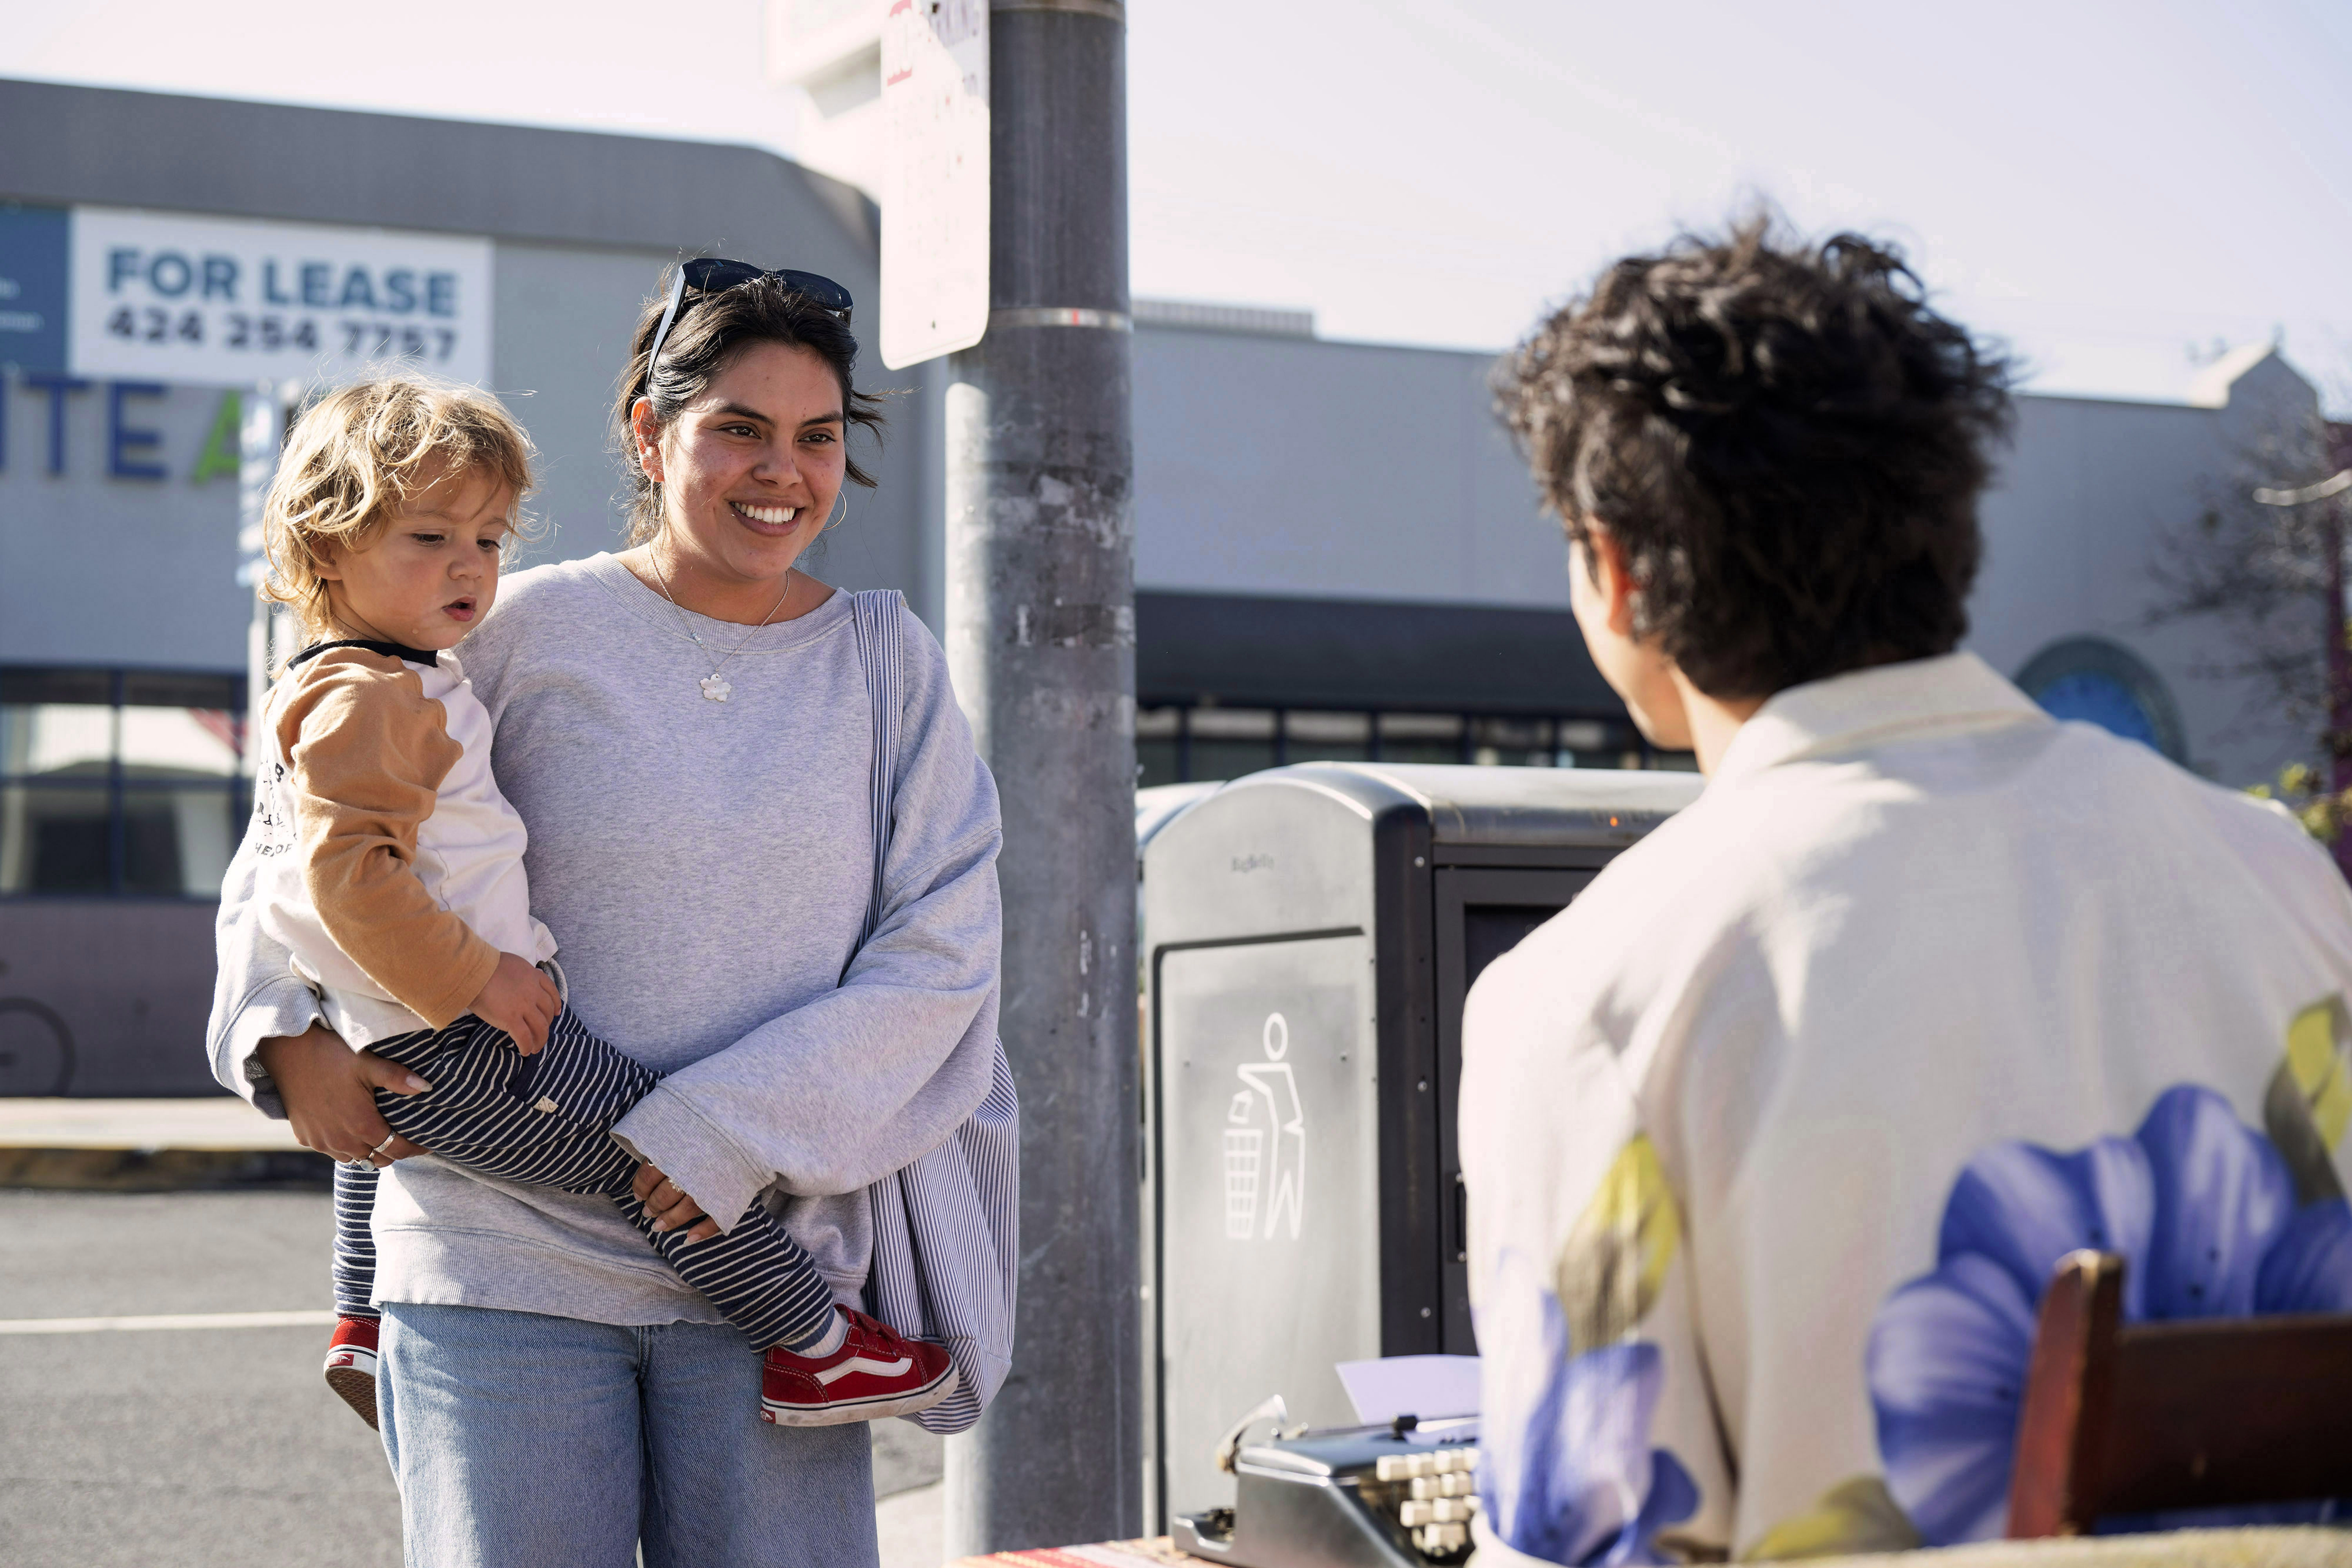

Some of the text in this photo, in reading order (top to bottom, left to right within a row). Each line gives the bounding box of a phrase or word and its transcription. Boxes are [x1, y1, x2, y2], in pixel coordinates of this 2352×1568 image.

[109, 250, 457, 317] FOR LEASE
[108, 307, 202, 344] 424
